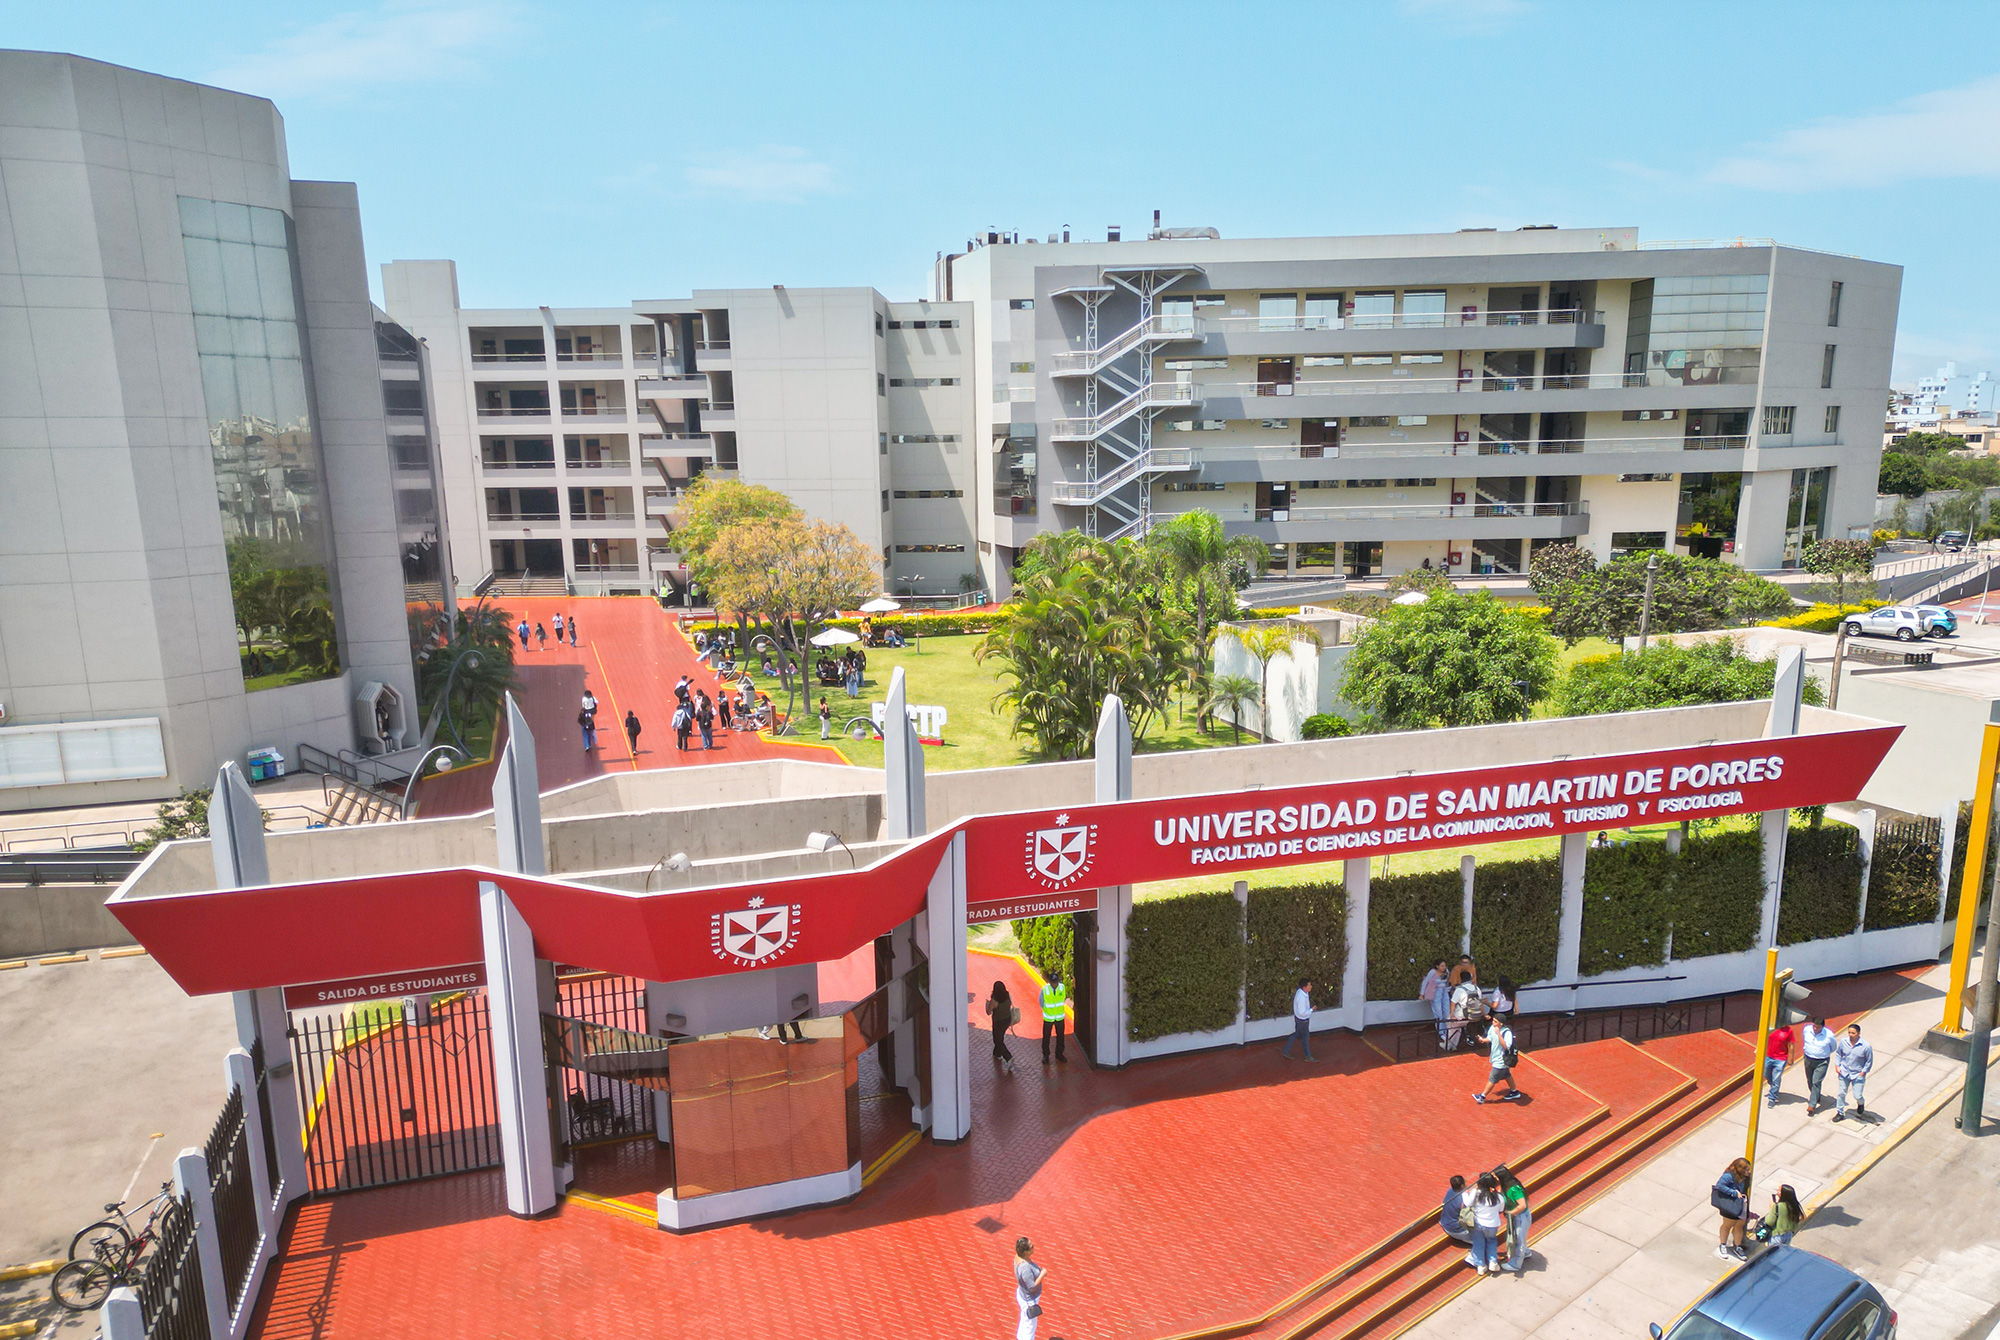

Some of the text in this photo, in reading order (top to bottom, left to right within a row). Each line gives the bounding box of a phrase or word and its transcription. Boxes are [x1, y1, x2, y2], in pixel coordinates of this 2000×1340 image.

[1154, 756, 1784, 846] UNIVERSIDAD DE SAN MARTIN DE PORRES
[1191, 791, 1744, 864] FACULTAD DE CIENCIAS DE LA COMUNICACION, TURISMO Y PSICOLOGIA
[1025, 831, 1037, 880] VERITAS
[1089, 824, 1098, 846] VOS
[711, 914, 727, 960] VERITAS
[792, 904, 801, 925] VOS
[966, 898, 1080, 919] RADA DE ESTUDIANTES
[318, 973, 477, 1001] SALIDA DE ESTUDIANTES
